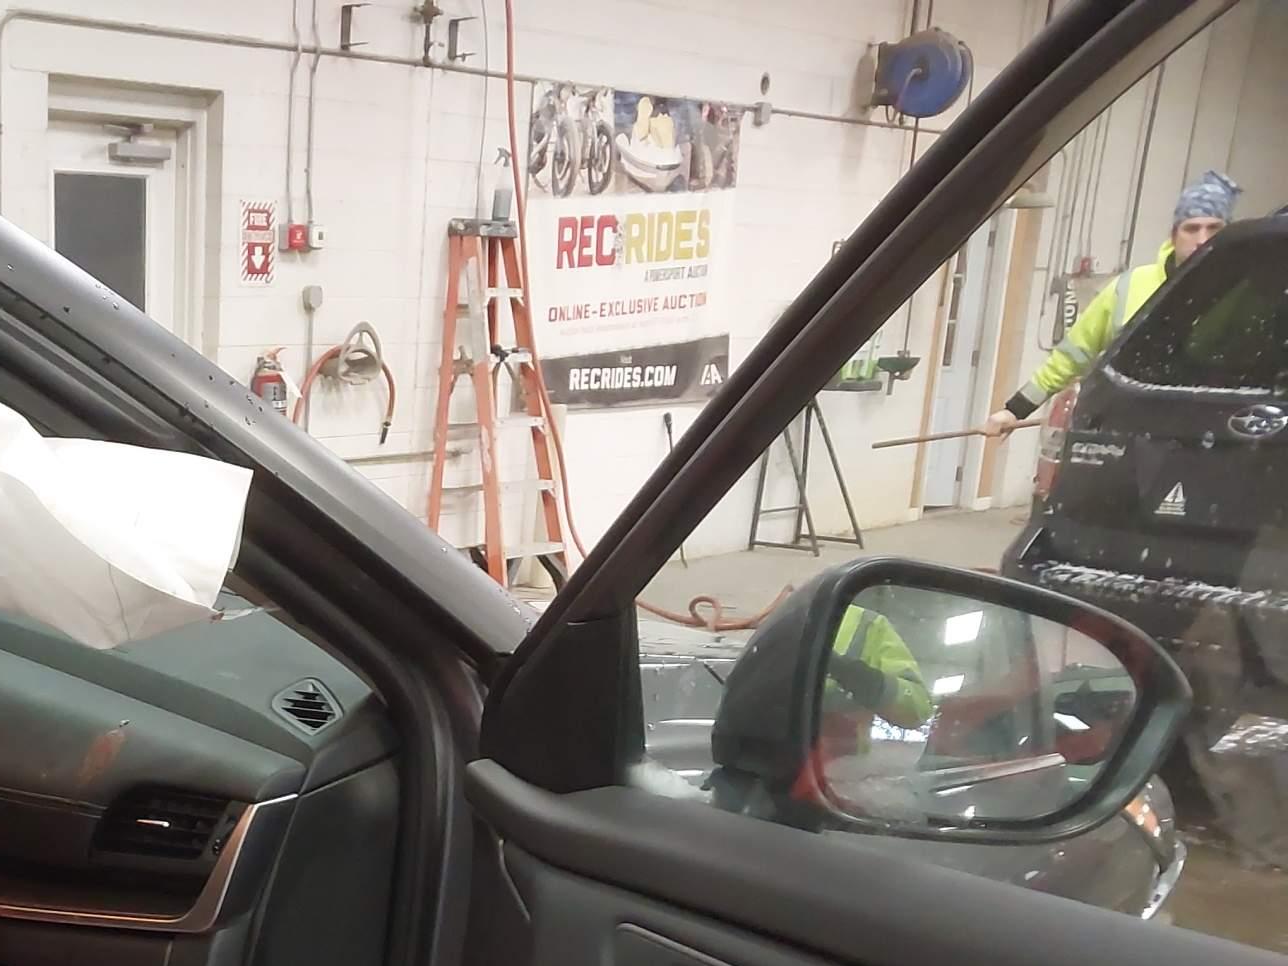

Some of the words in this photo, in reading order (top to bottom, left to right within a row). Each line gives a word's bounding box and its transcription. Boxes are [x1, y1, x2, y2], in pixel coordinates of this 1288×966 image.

[556, 215, 617, 269] REC
[624, 209, 710, 264] RIDES
[548, 298, 659, 322] ONLINE-EXCLUSIVE
[569, 365, 678, 391] RECRIDES.COM
